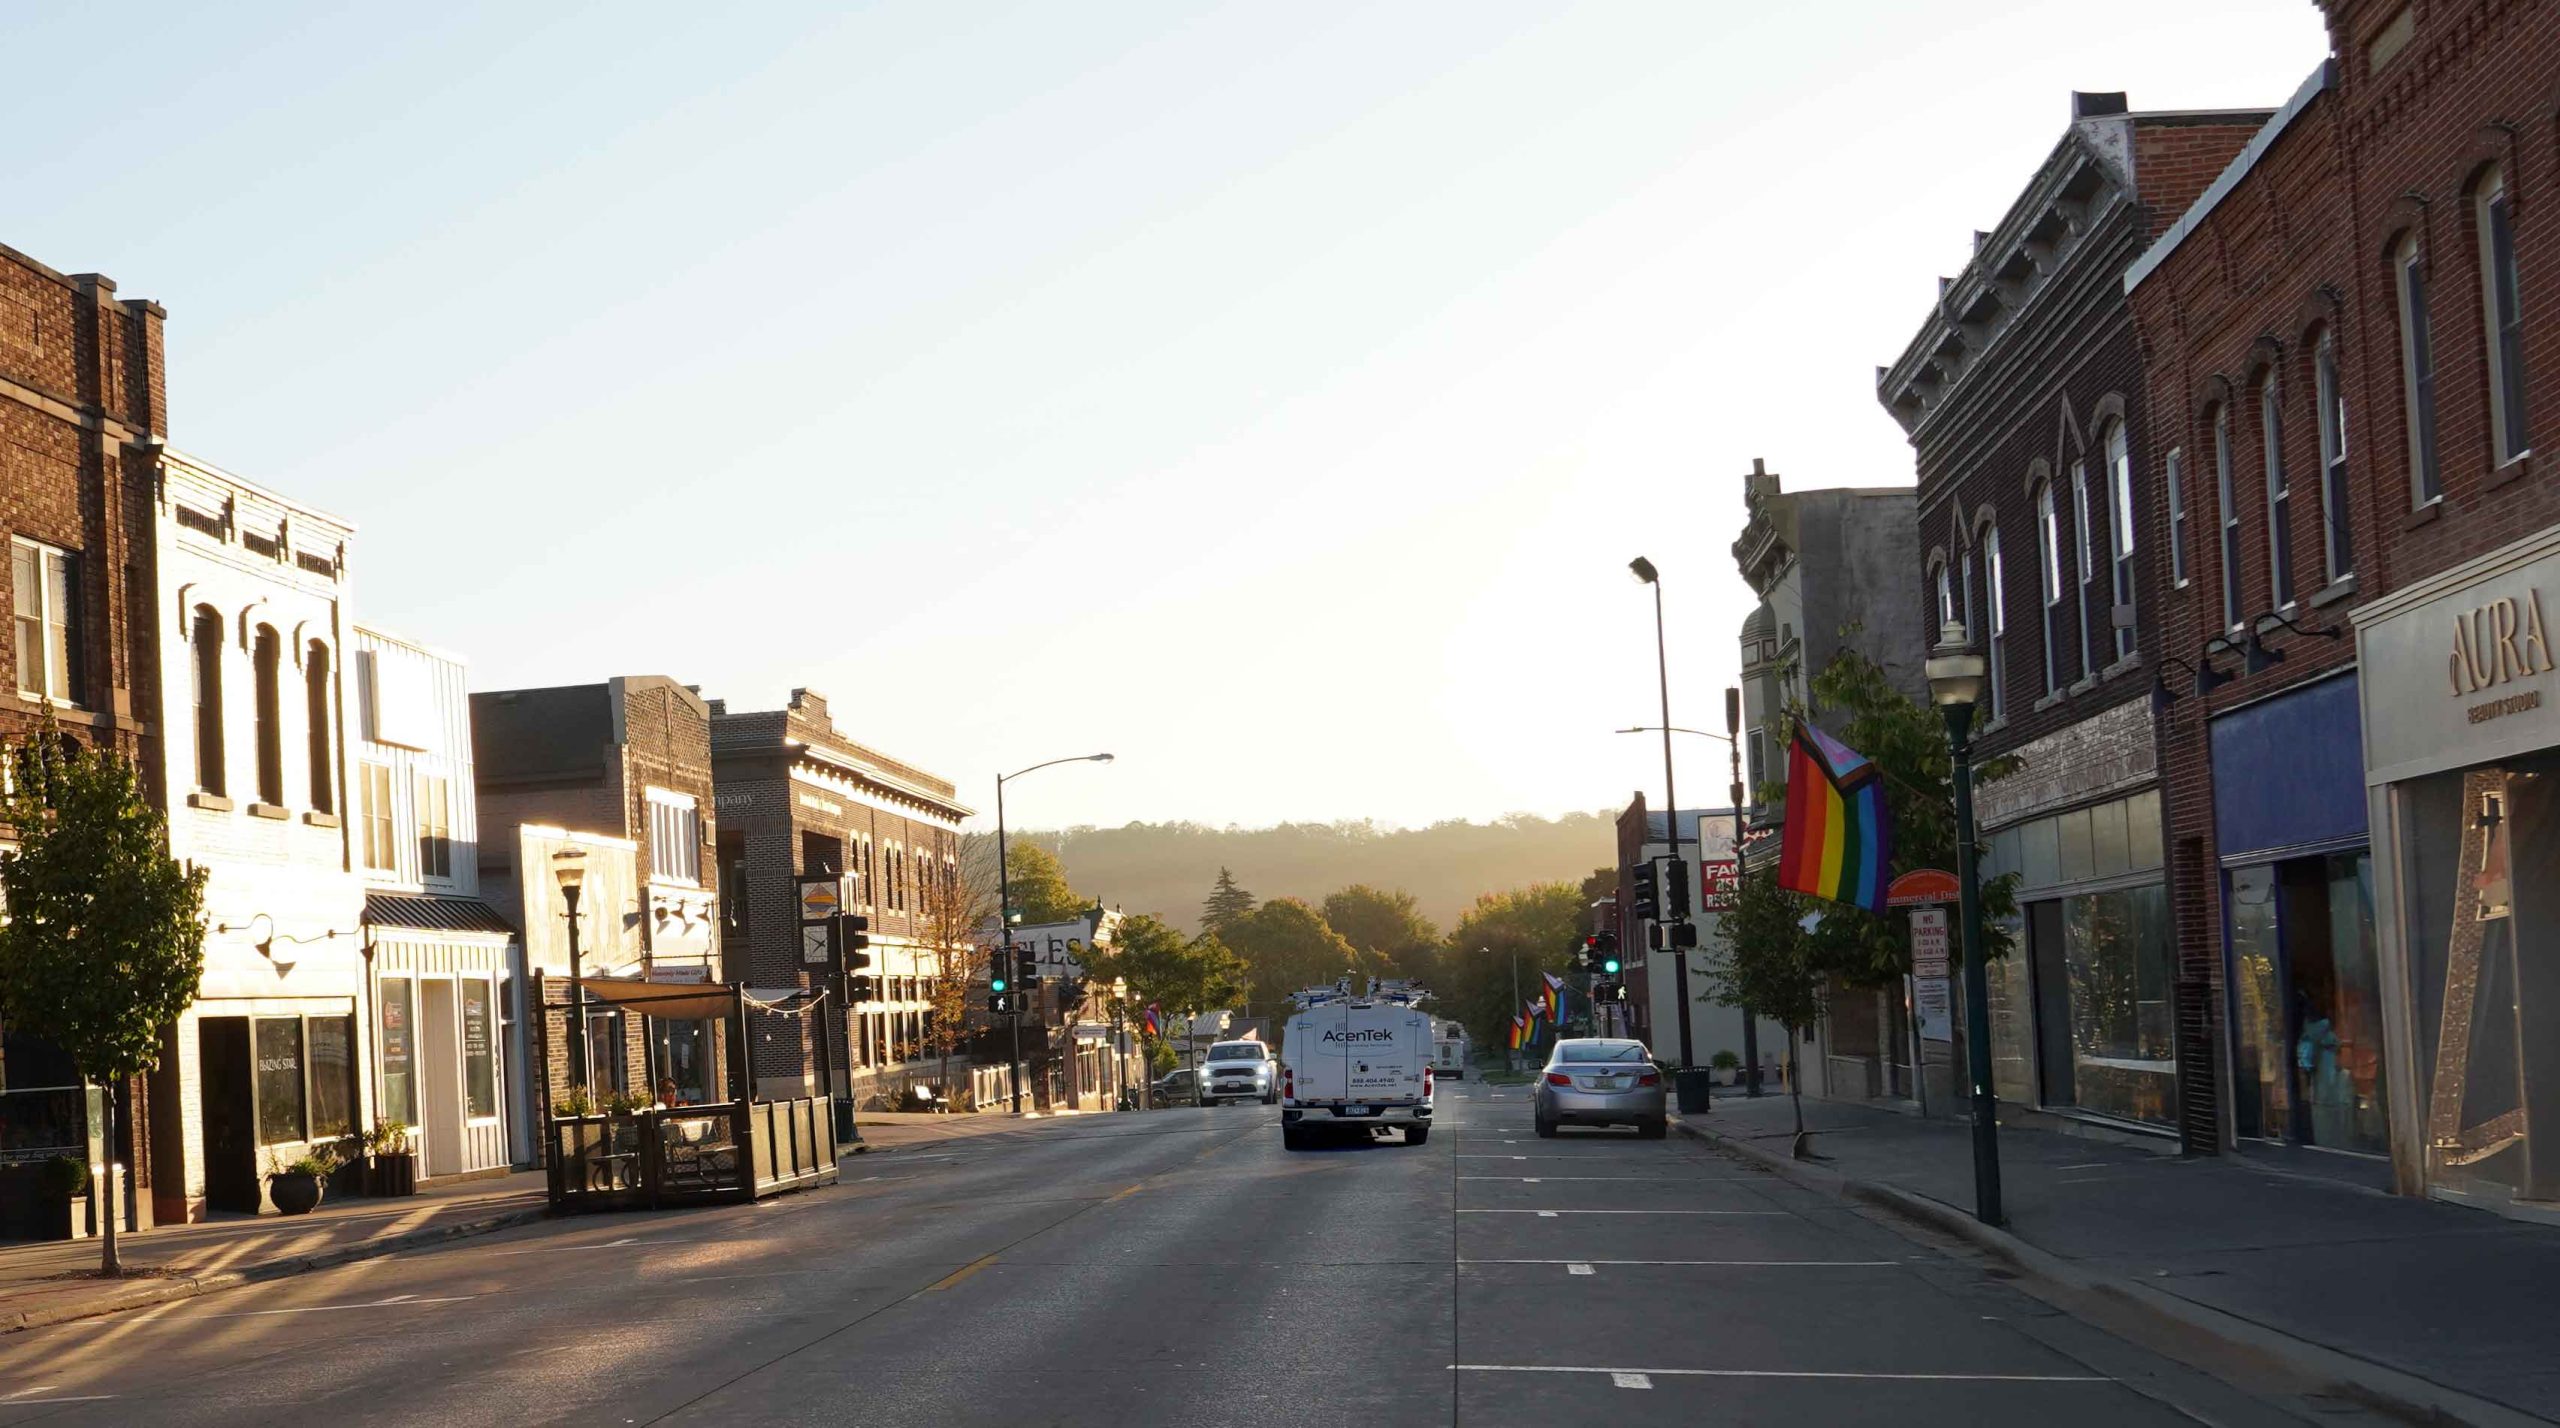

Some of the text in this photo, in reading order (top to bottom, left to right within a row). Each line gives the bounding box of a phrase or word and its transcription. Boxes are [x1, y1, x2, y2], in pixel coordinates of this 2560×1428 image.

[2449, 588, 2553, 697] AURA
[1922, 914, 1934, 924] NO
[1913, 926, 1945, 937] PARKING
[1322, 1029, 1393, 1042] AcenTek
